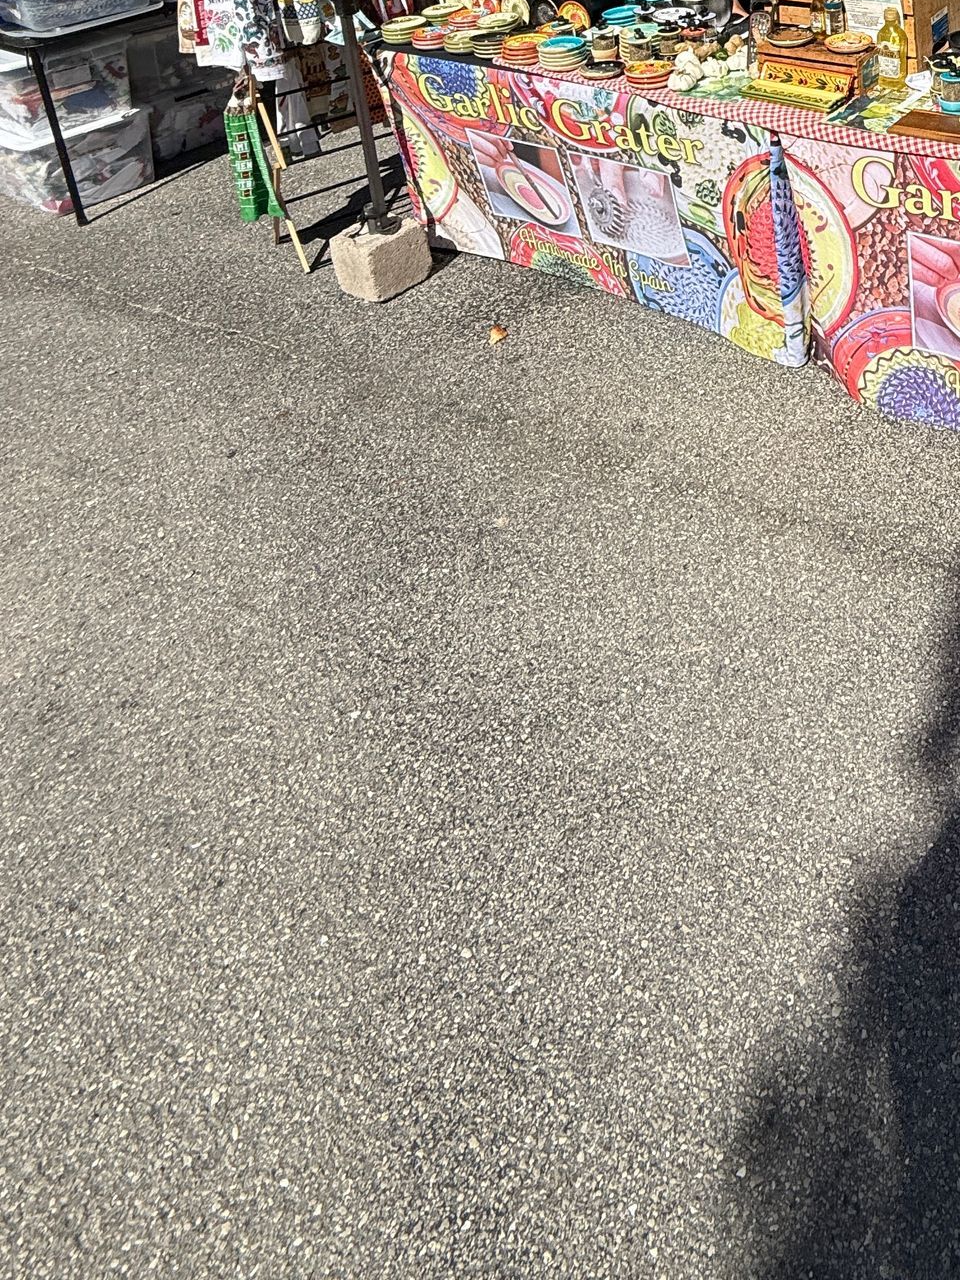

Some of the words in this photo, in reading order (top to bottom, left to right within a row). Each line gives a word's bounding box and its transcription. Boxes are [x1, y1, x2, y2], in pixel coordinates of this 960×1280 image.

[417, 73, 543, 132] Garlic
[551, 98, 704, 166] Grater
[519, 228, 601, 271] Handmade
[603, 253, 627, 278] In
[628, 261, 675, 294] Spain
